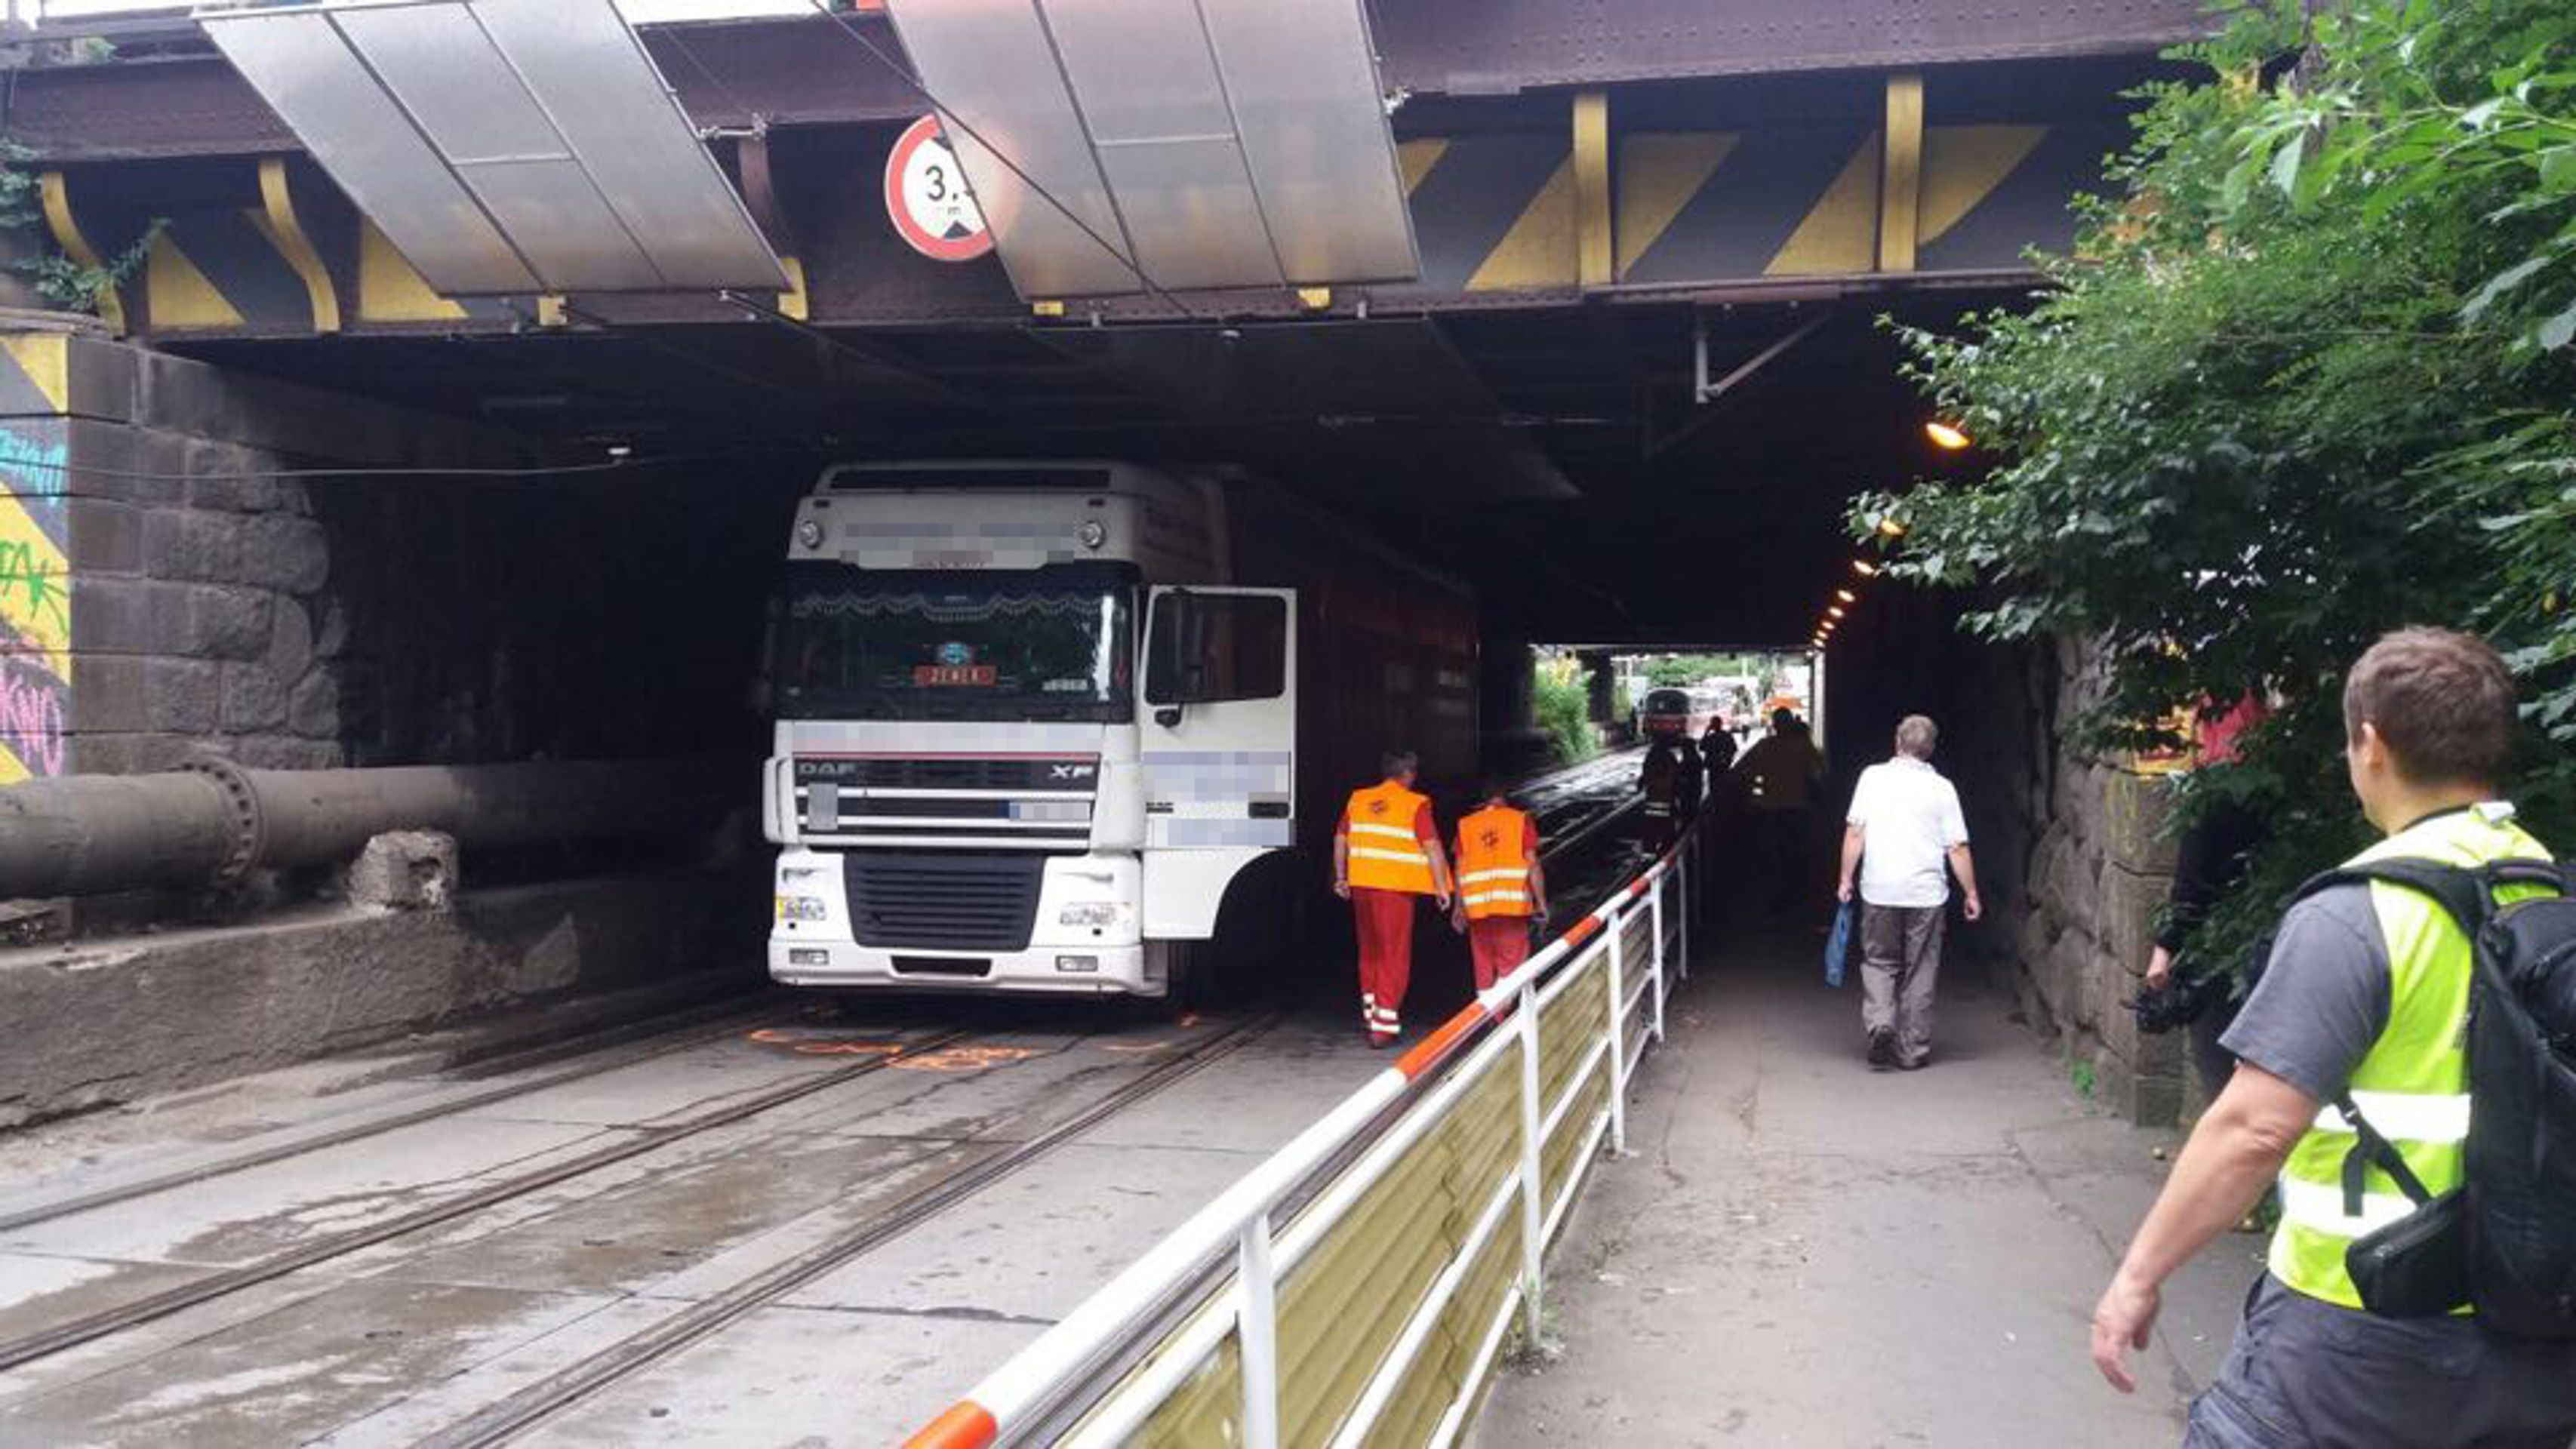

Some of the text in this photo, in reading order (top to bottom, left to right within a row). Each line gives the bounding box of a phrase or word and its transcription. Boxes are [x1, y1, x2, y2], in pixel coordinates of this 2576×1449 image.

[925, 165, 974, 202] 3.
[799, 762, 856, 775] DAF
[1049, 764, 1094, 779] XF
